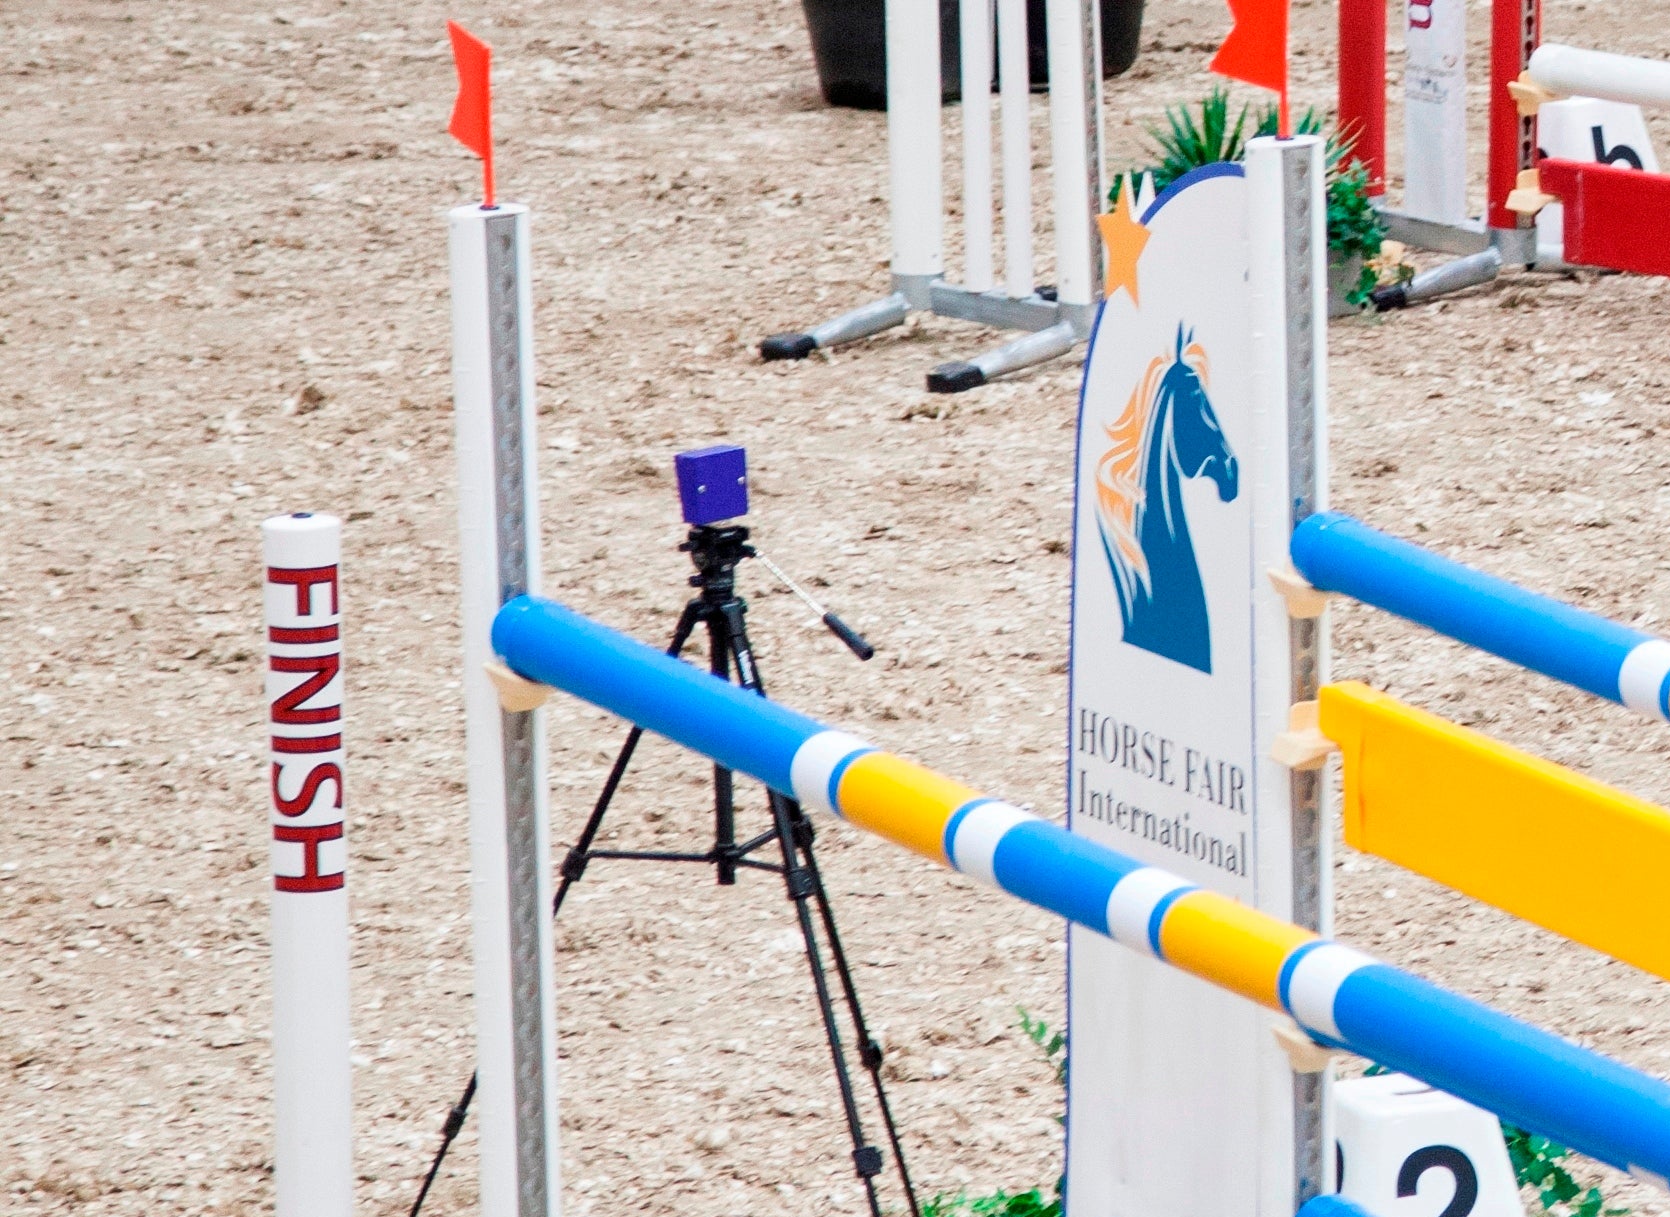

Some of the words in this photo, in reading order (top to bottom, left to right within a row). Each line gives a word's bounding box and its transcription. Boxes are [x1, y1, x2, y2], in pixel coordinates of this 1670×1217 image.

[267, 563, 345, 893] FINISH
[1078, 707, 1176, 787] HORSE
[1183, 746, 1248, 815] FAIR
[1077, 769, 1247, 878] International
